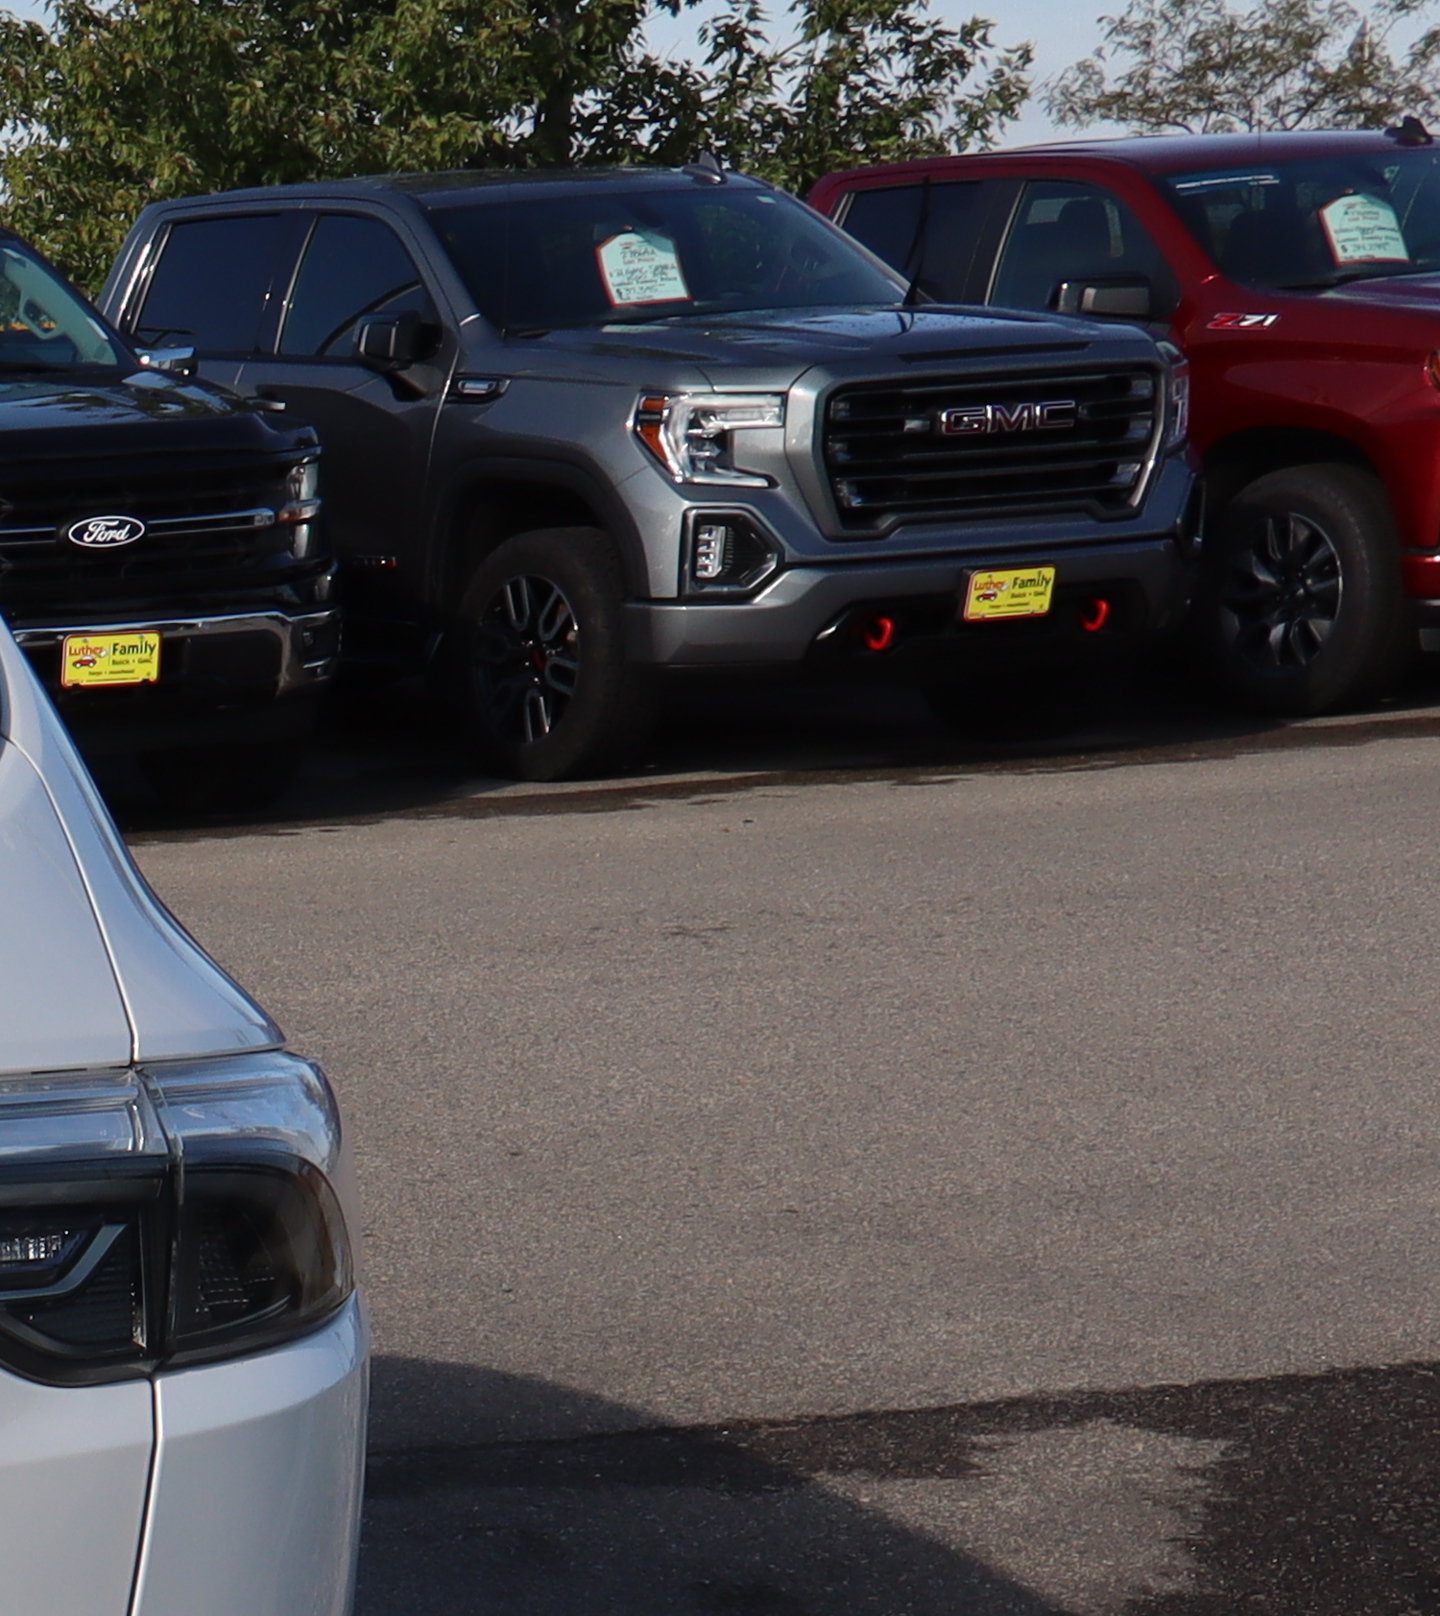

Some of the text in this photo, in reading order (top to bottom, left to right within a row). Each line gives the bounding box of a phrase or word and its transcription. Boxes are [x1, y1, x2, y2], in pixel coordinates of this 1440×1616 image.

[1207, 312, 1281, 330] Z71
[941, 401, 1076, 435] GMC
[82, 520, 132, 543] Ford
[1012, 573, 1052, 592] Family
[68, 640, 156, 656] Luther Family
